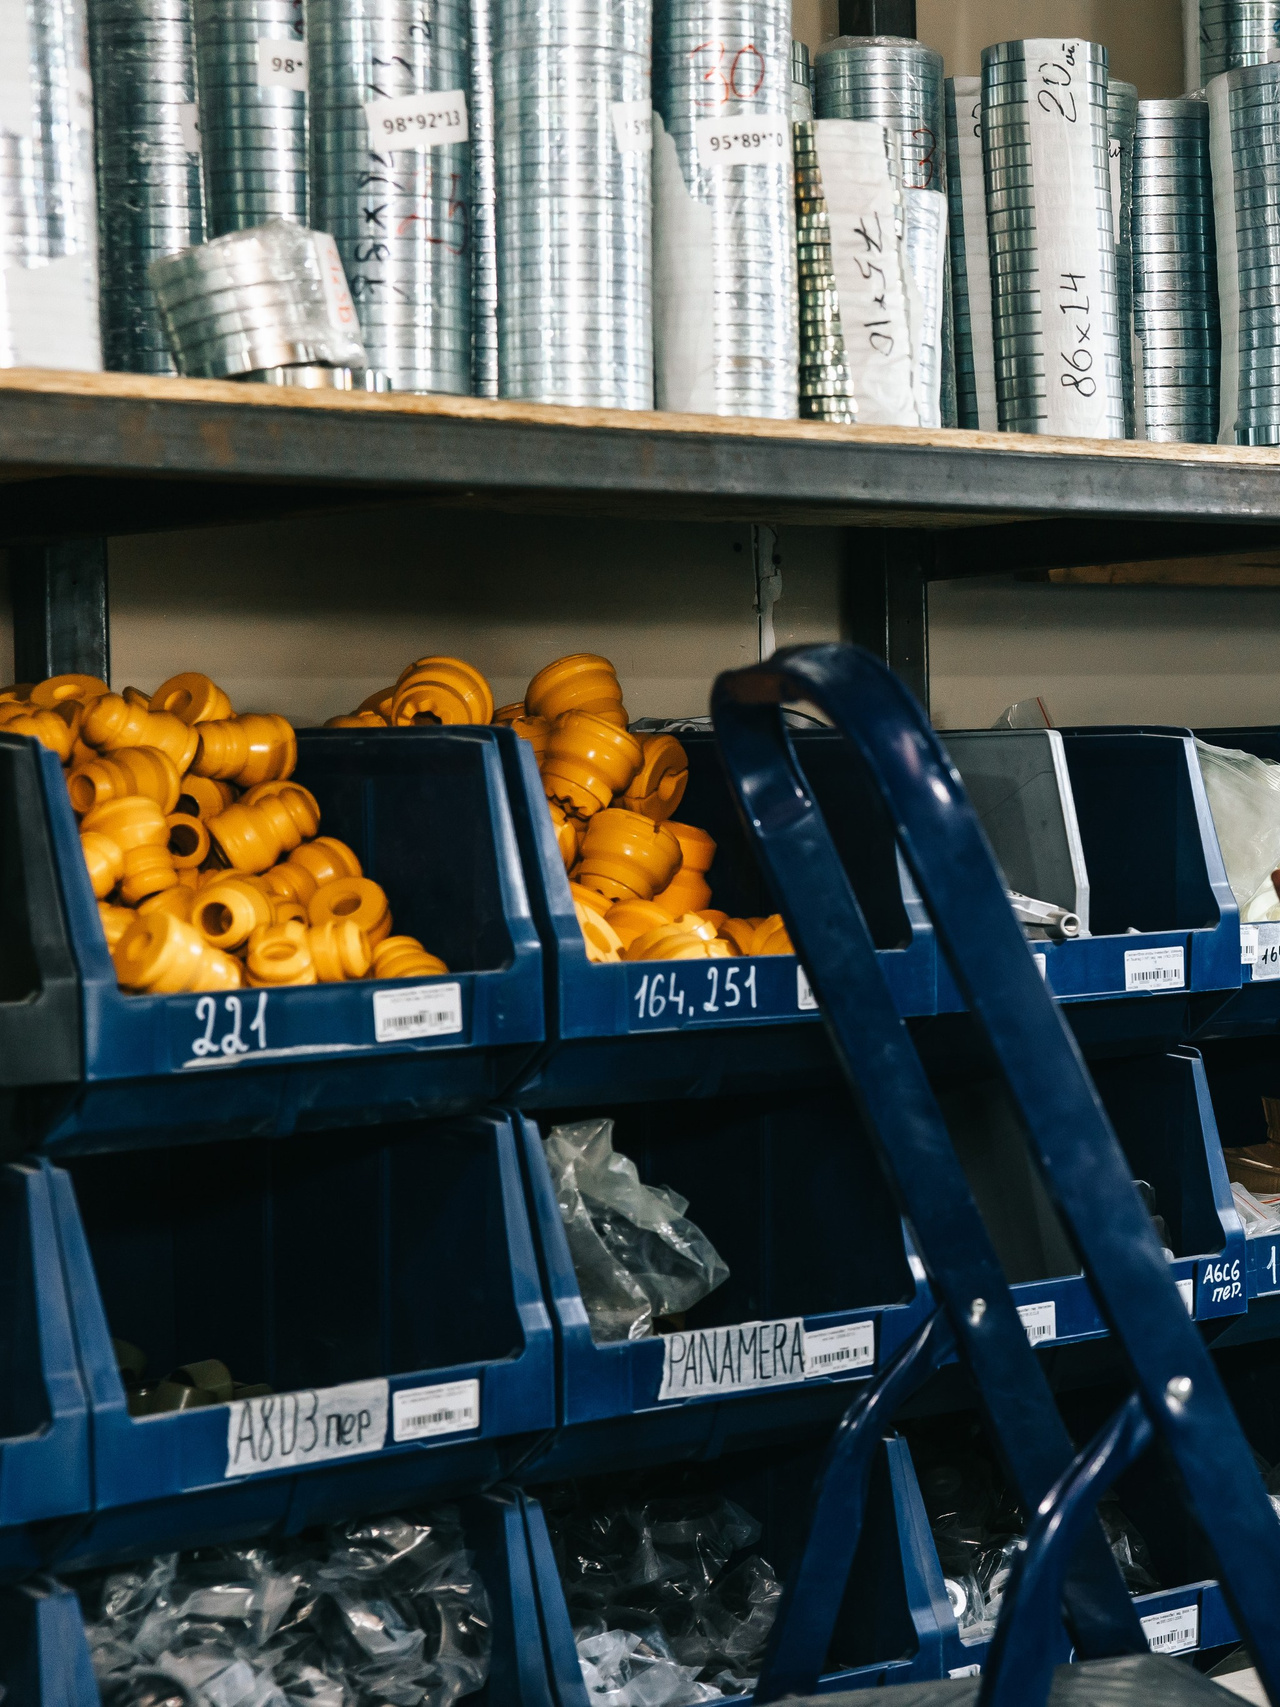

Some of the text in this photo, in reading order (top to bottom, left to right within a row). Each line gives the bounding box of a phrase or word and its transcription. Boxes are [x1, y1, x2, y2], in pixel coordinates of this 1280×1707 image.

[1037, 62, 1078, 123] 20
[710, 132, 783, 151] 95890
[1060, 273, 1097, 398] 86x14
[192, 991, 268, 1055] 221
[668, 1321, 805, 1388] PANAMERA
